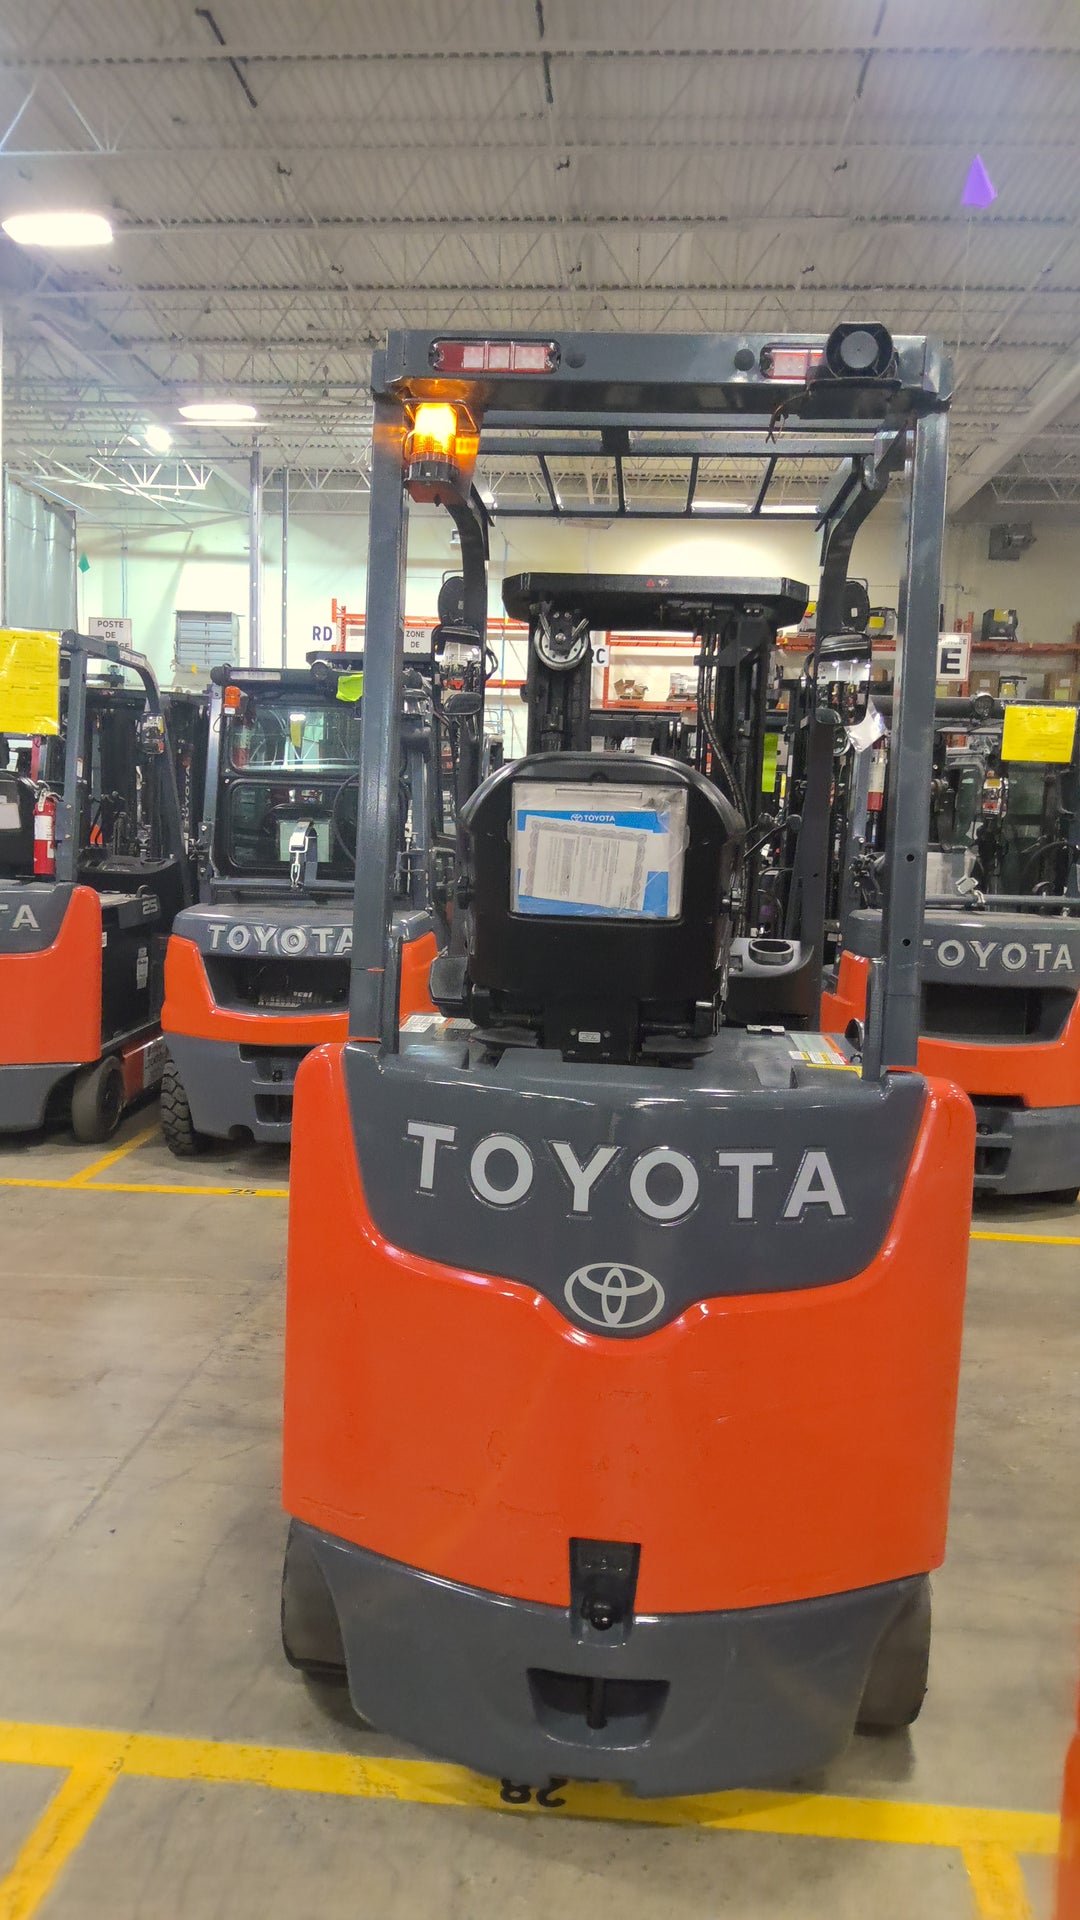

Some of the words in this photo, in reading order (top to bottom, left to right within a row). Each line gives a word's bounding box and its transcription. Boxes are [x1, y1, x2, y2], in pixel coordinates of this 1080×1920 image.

[97, 620, 124, 628] POSTE
[105, 631, 116, 639] DE
[312, 626, 333, 641] RD
[406, 630, 425, 638] ZONE
[940, 647, 962, 674] E
[583, 814, 616, 822] TOYOTA
[209, 924, 353, 955] TOYOTA
[407, 1121, 847, 1220] TOYOTA
